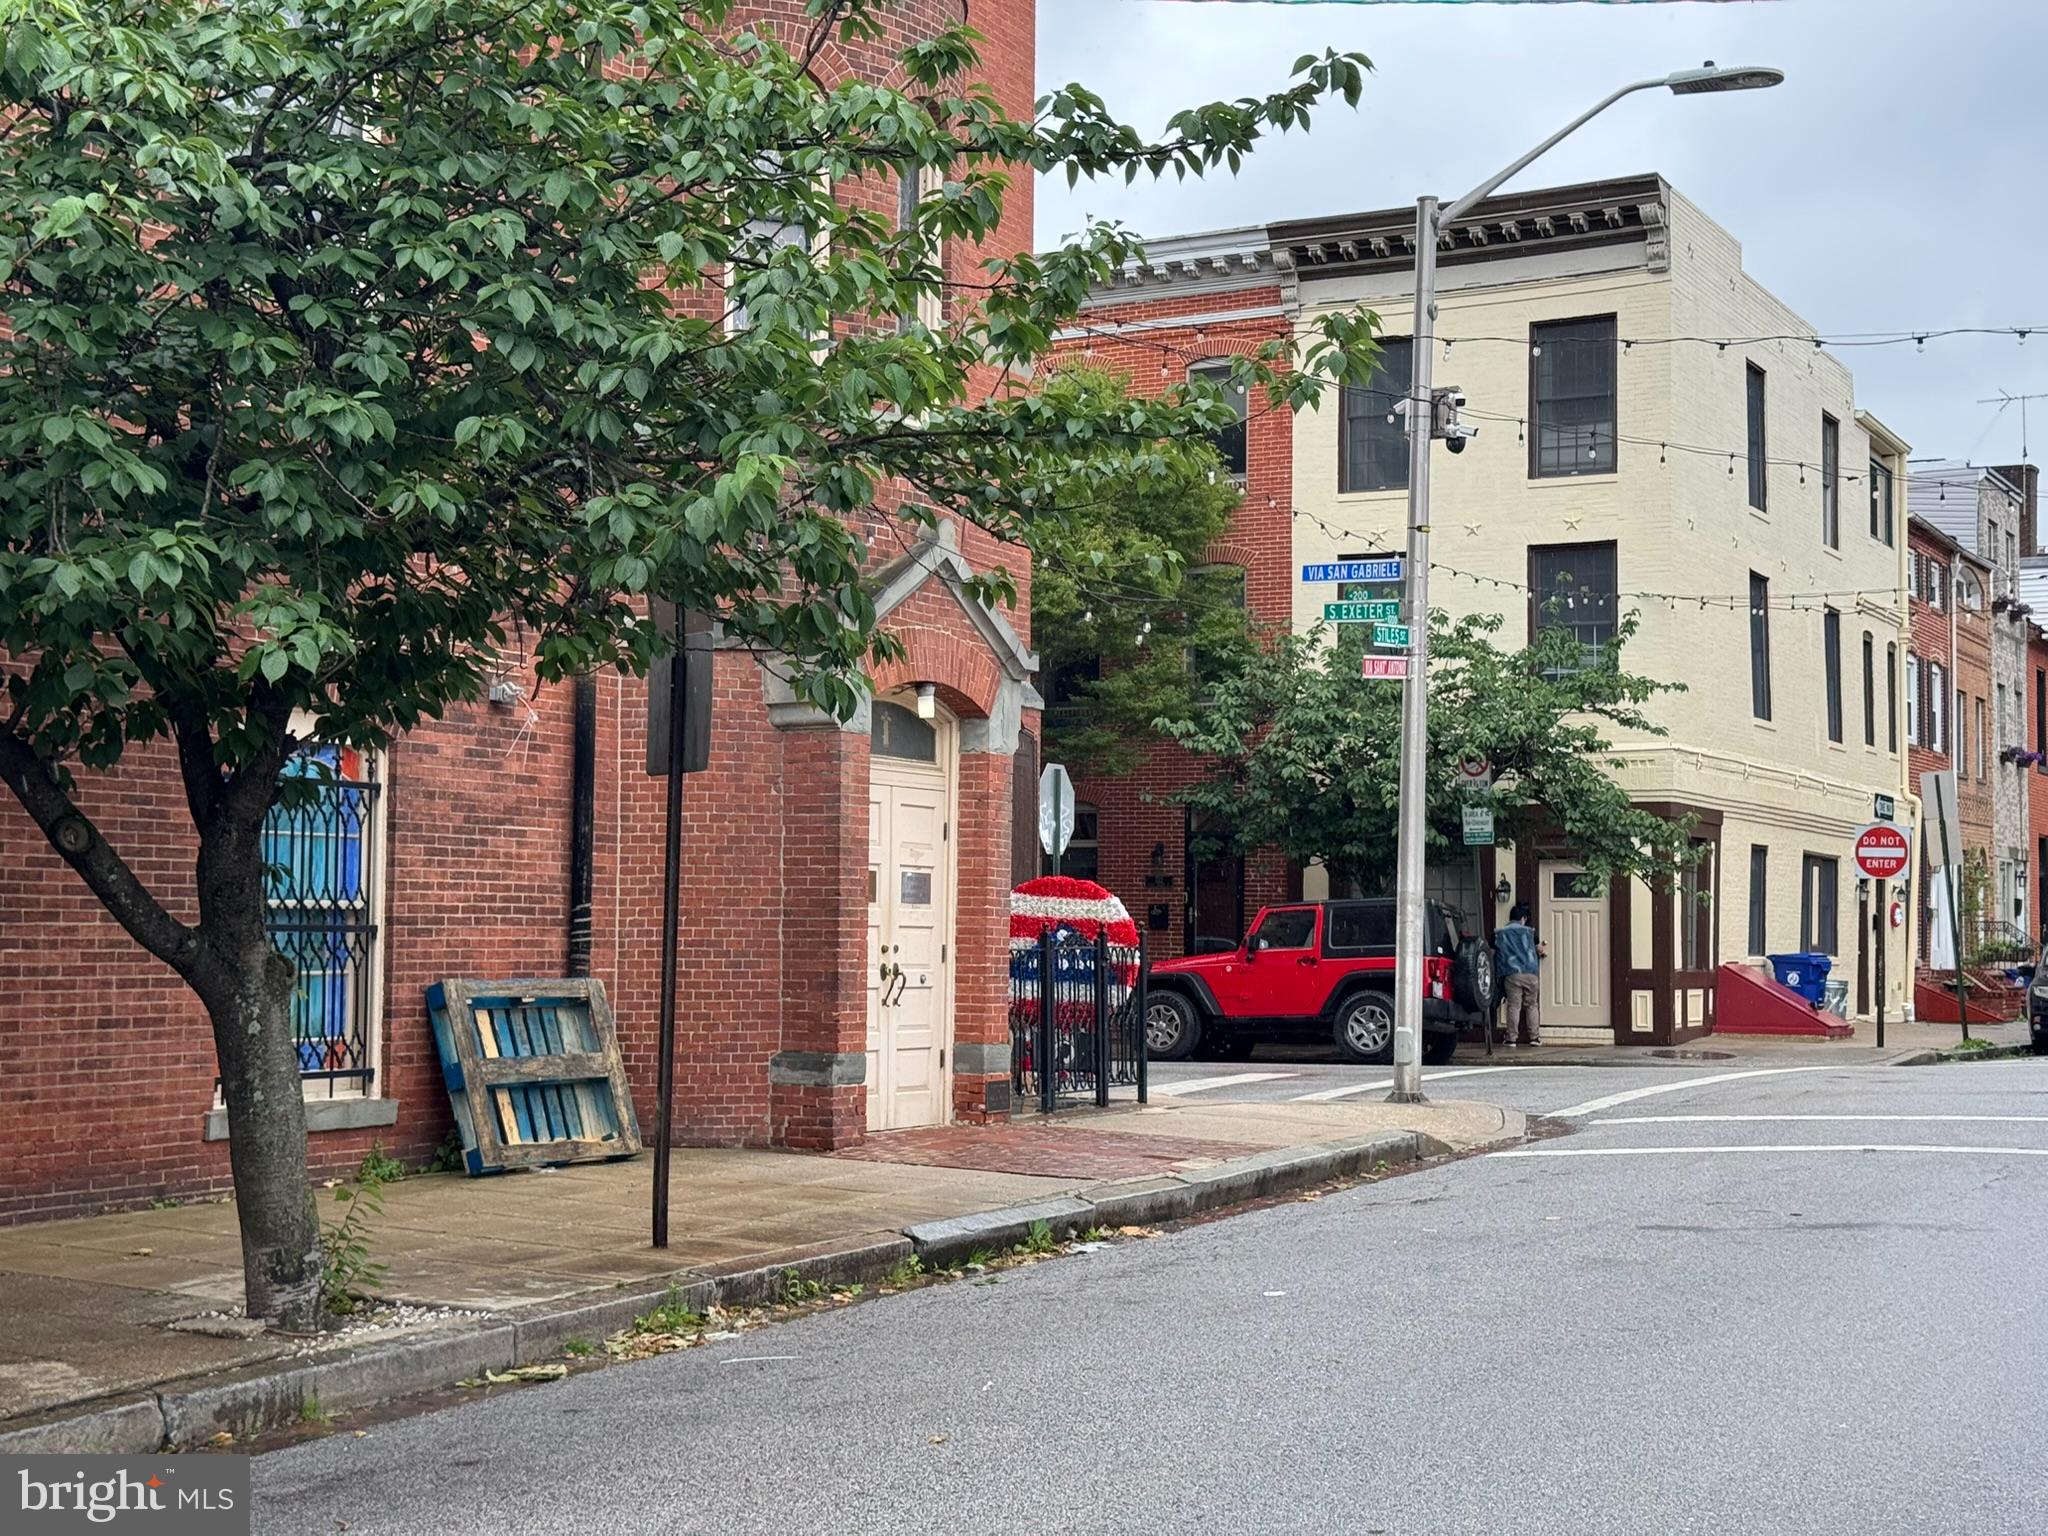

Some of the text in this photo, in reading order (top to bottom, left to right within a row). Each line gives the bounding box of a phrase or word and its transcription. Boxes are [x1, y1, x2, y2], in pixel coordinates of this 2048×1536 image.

[1308, 562, 1398, 580] VIA SAN GABRIELE
[1352, 590, 1369, 600] 200
[1329, 603, 1396, 619] S. EXETER ST.
[1376, 627, 1400, 644] STILES
[1365, 660, 1373, 675] VIA
[1863, 836, 1900, 846] DO NOT
[1866, 859, 1897, 869] ENTER
